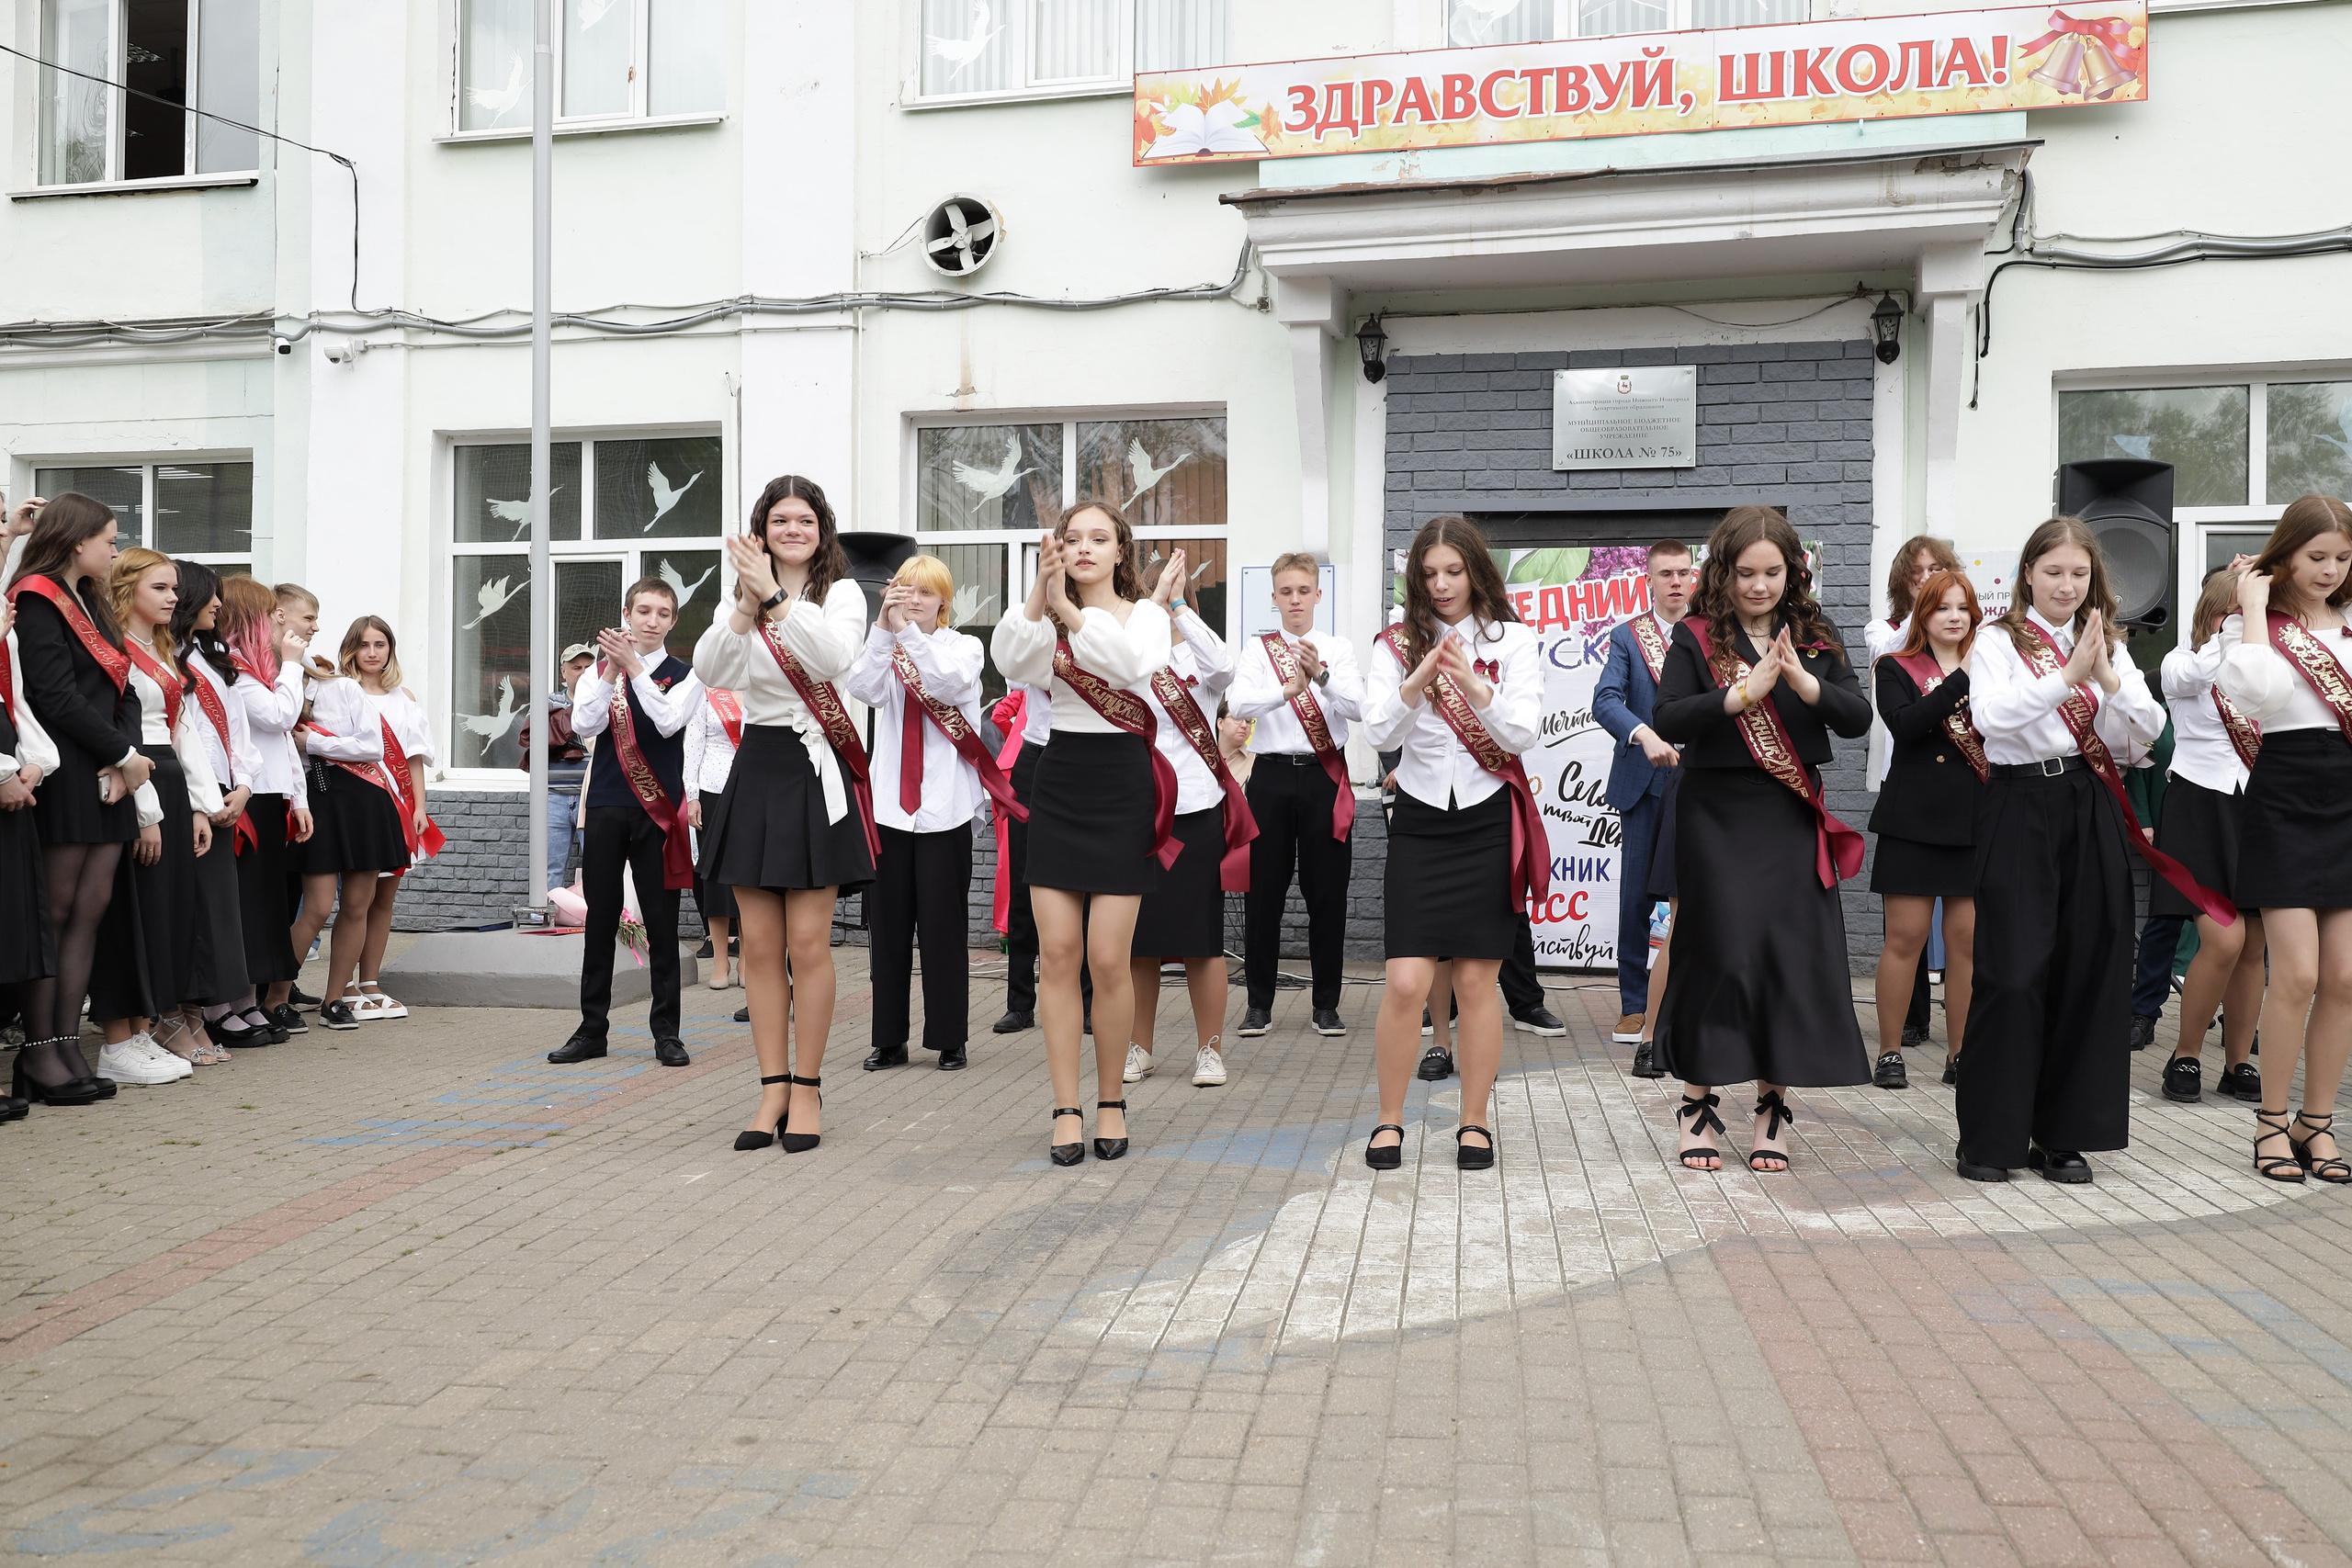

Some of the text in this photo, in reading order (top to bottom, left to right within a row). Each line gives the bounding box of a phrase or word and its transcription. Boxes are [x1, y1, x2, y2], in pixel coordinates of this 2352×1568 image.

[1284, 34, 2009, 139] ЗДРАВСТВУЙ, ШКОЛА!
[1580, 424, 1668, 433] ОБЩЕОБРАЗОВАТЕЛЬНОЕ
[1634, 417, 1681, 425] БЮДЖЕТНОЕ
[1566, 446, 1682, 460] «ШКОЛА № 75»
[1510, 570, 1649, 635] ЕДНИЙ
[819, 702, 855, 749] 2025
[933, 702, 972, 741] 2025
[1303, 716, 1335, 752] 2025
[1537, 707, 1596, 741] Мечта
[1193, 730, 1220, 770] 2025
[1464, 723, 1512, 772] 2025
[628, 764, 665, 802] 2025
[1544, 803, 1594, 828] твой
